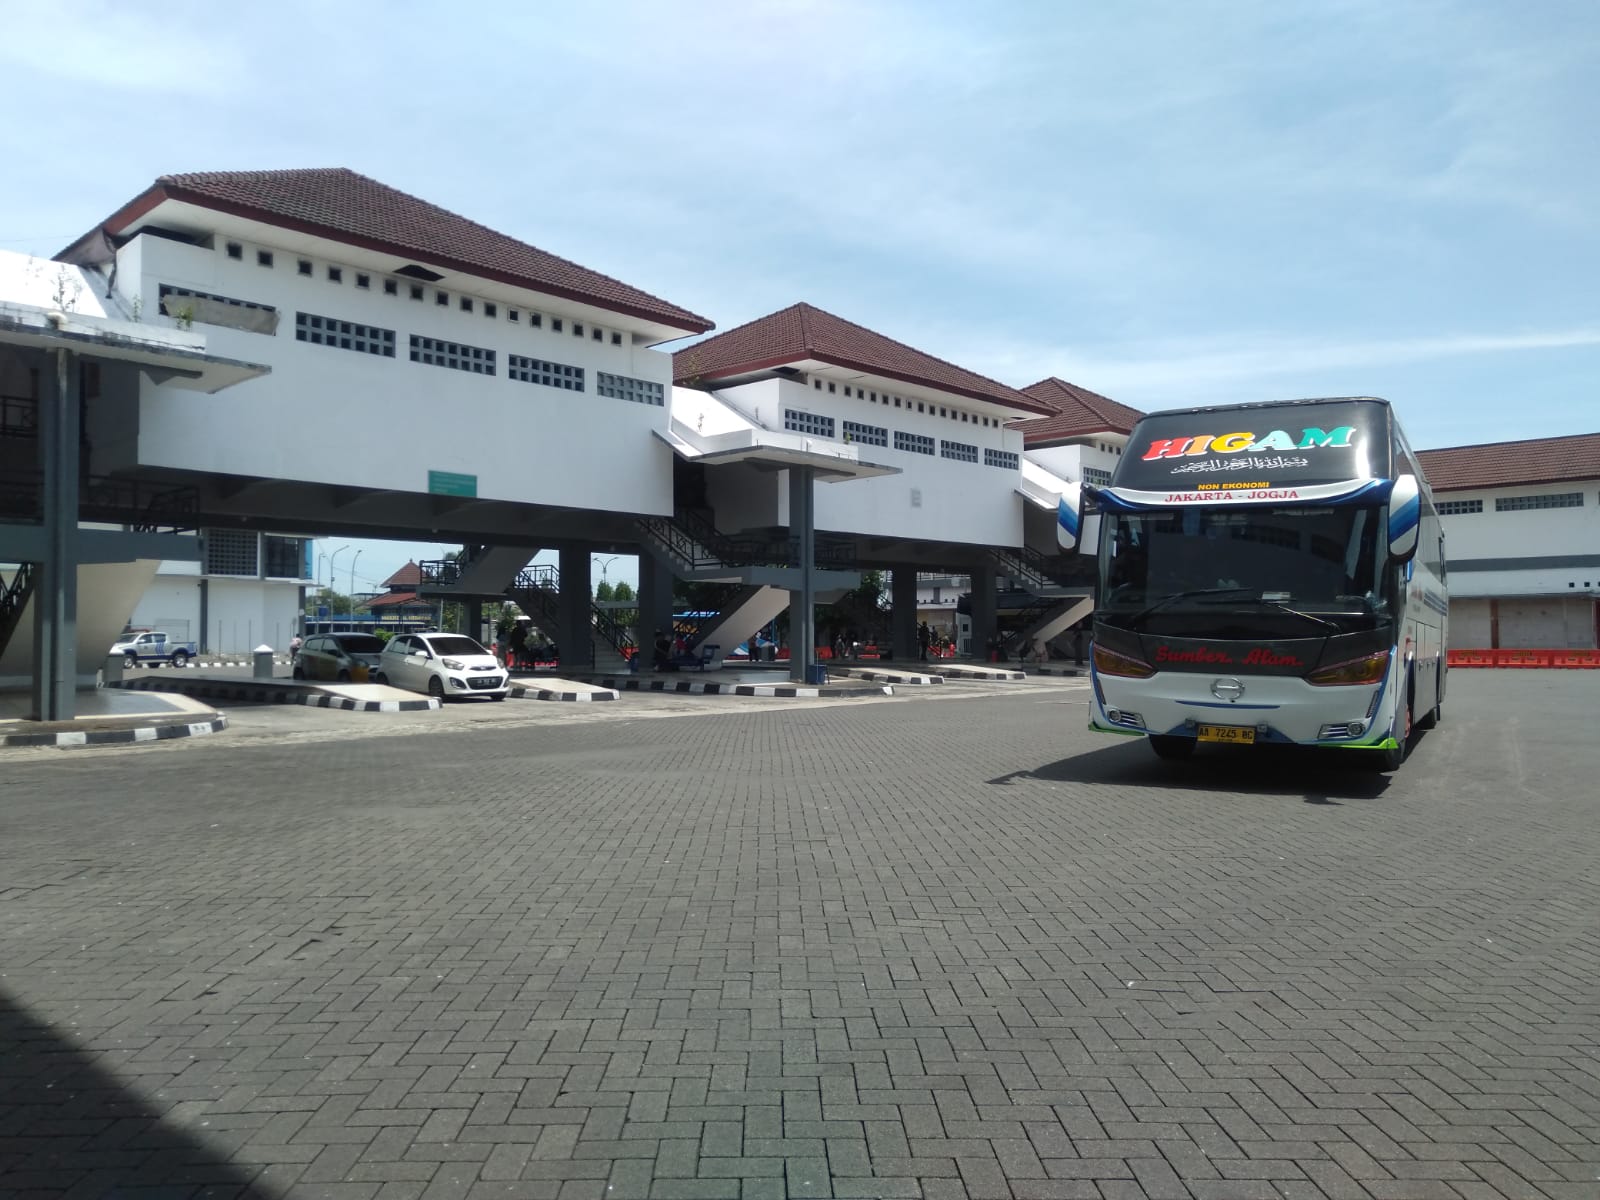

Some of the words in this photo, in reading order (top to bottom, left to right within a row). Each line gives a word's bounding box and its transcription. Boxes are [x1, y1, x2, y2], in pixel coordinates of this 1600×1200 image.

[1142, 426, 1357, 460] HIGAM
[1197, 483, 1220, 491] NON
[1222, 481, 1270, 489] EKONOMI
[1165, 492, 1233, 502] JAKARTA
[1247, 490, 1299, 499] JOGJA
